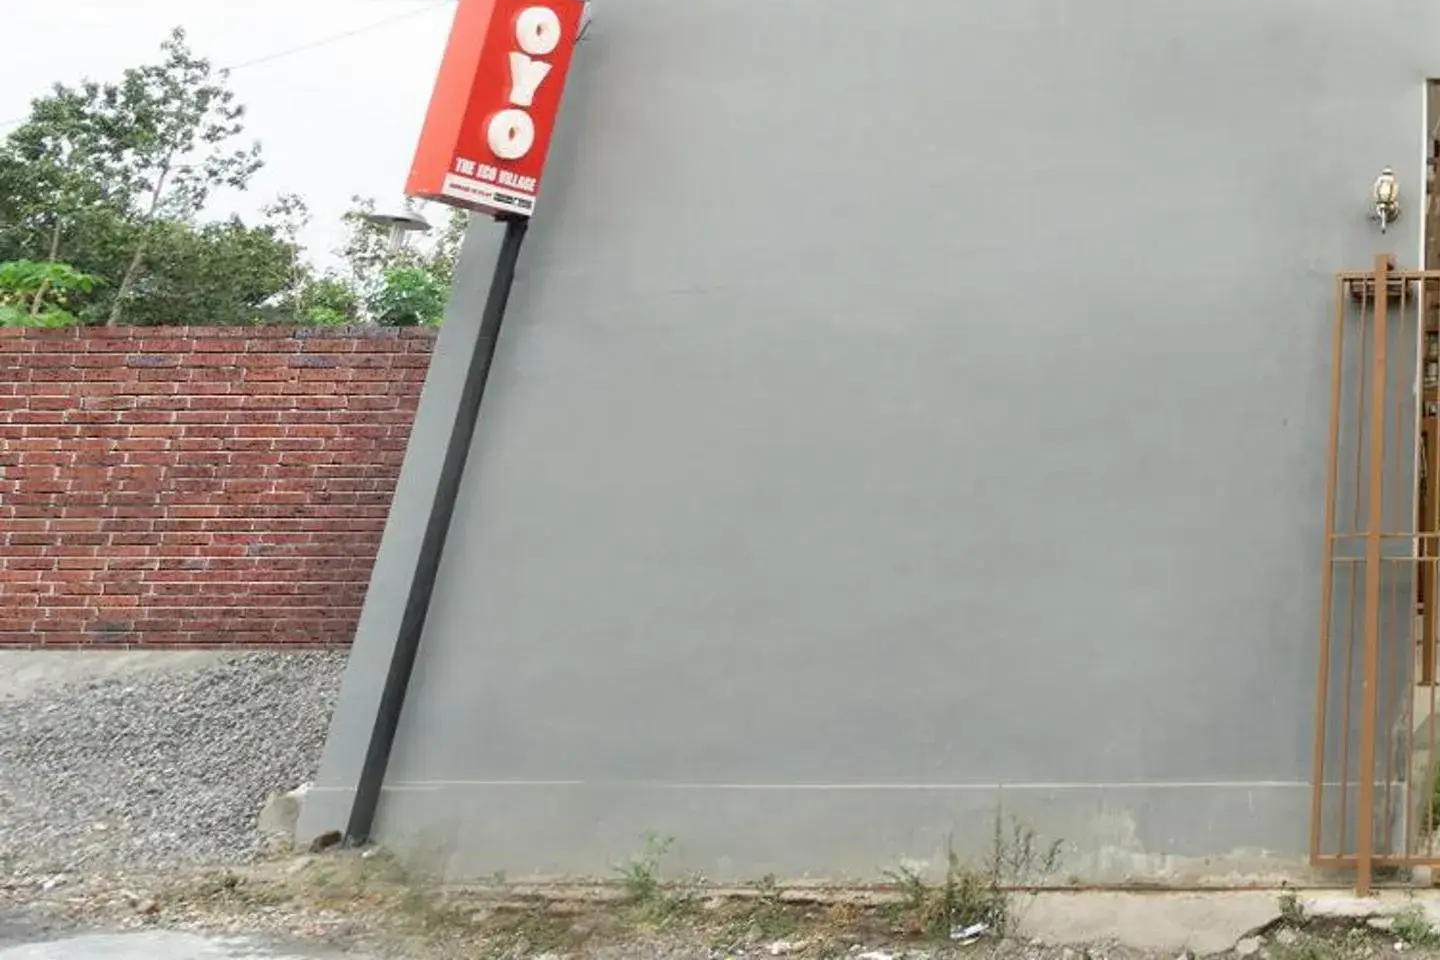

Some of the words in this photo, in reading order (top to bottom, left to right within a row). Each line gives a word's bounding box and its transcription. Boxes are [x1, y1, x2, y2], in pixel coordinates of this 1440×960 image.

[488, 7, 561, 158] OYO
[456, 157, 475, 176] THE
[476, 163, 497, 182] ECO
[498, 170, 537, 192] VILLAGE
